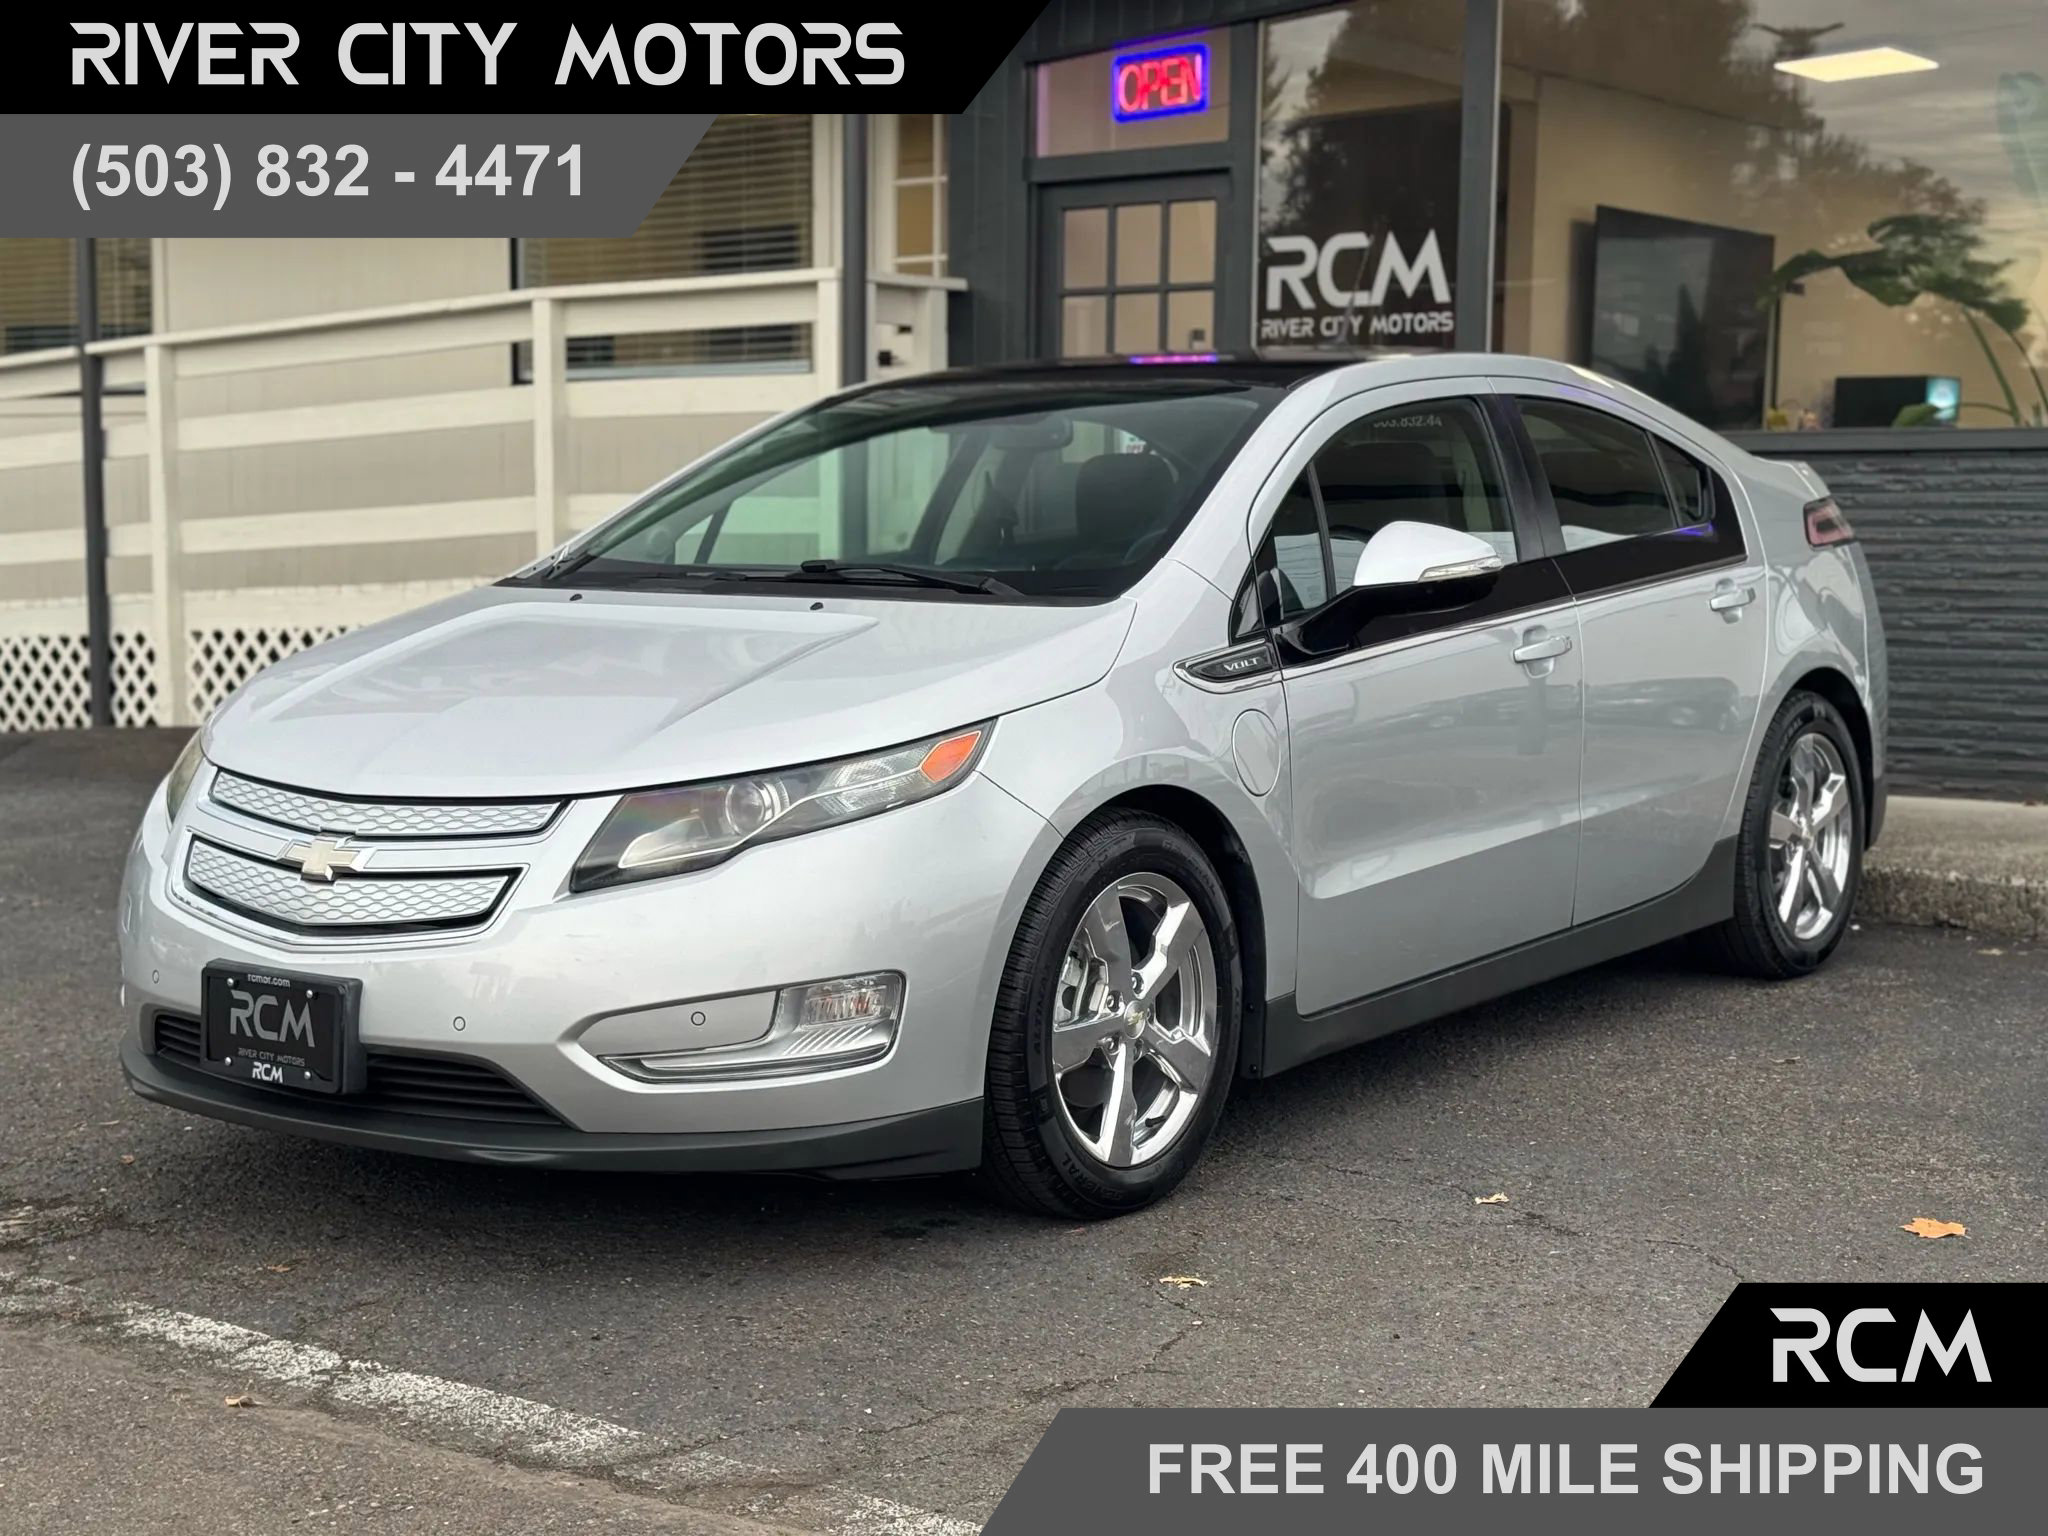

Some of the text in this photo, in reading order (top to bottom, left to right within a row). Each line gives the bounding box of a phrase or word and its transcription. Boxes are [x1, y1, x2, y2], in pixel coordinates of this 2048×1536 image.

[1118, 54, 1202, 112] OPEN
[1266, 228, 1451, 311] RCM
[1261, 316, 1314, 340] RIVER
[1369, 310, 1454, 335] MOTORS
[1223, 657, 1259, 672] VOLT
[230, 989, 316, 1048] RCM
[238, 1047, 306, 1068] RIVER CITY MOTORS
[252, 1061, 284, 1084] RCM
